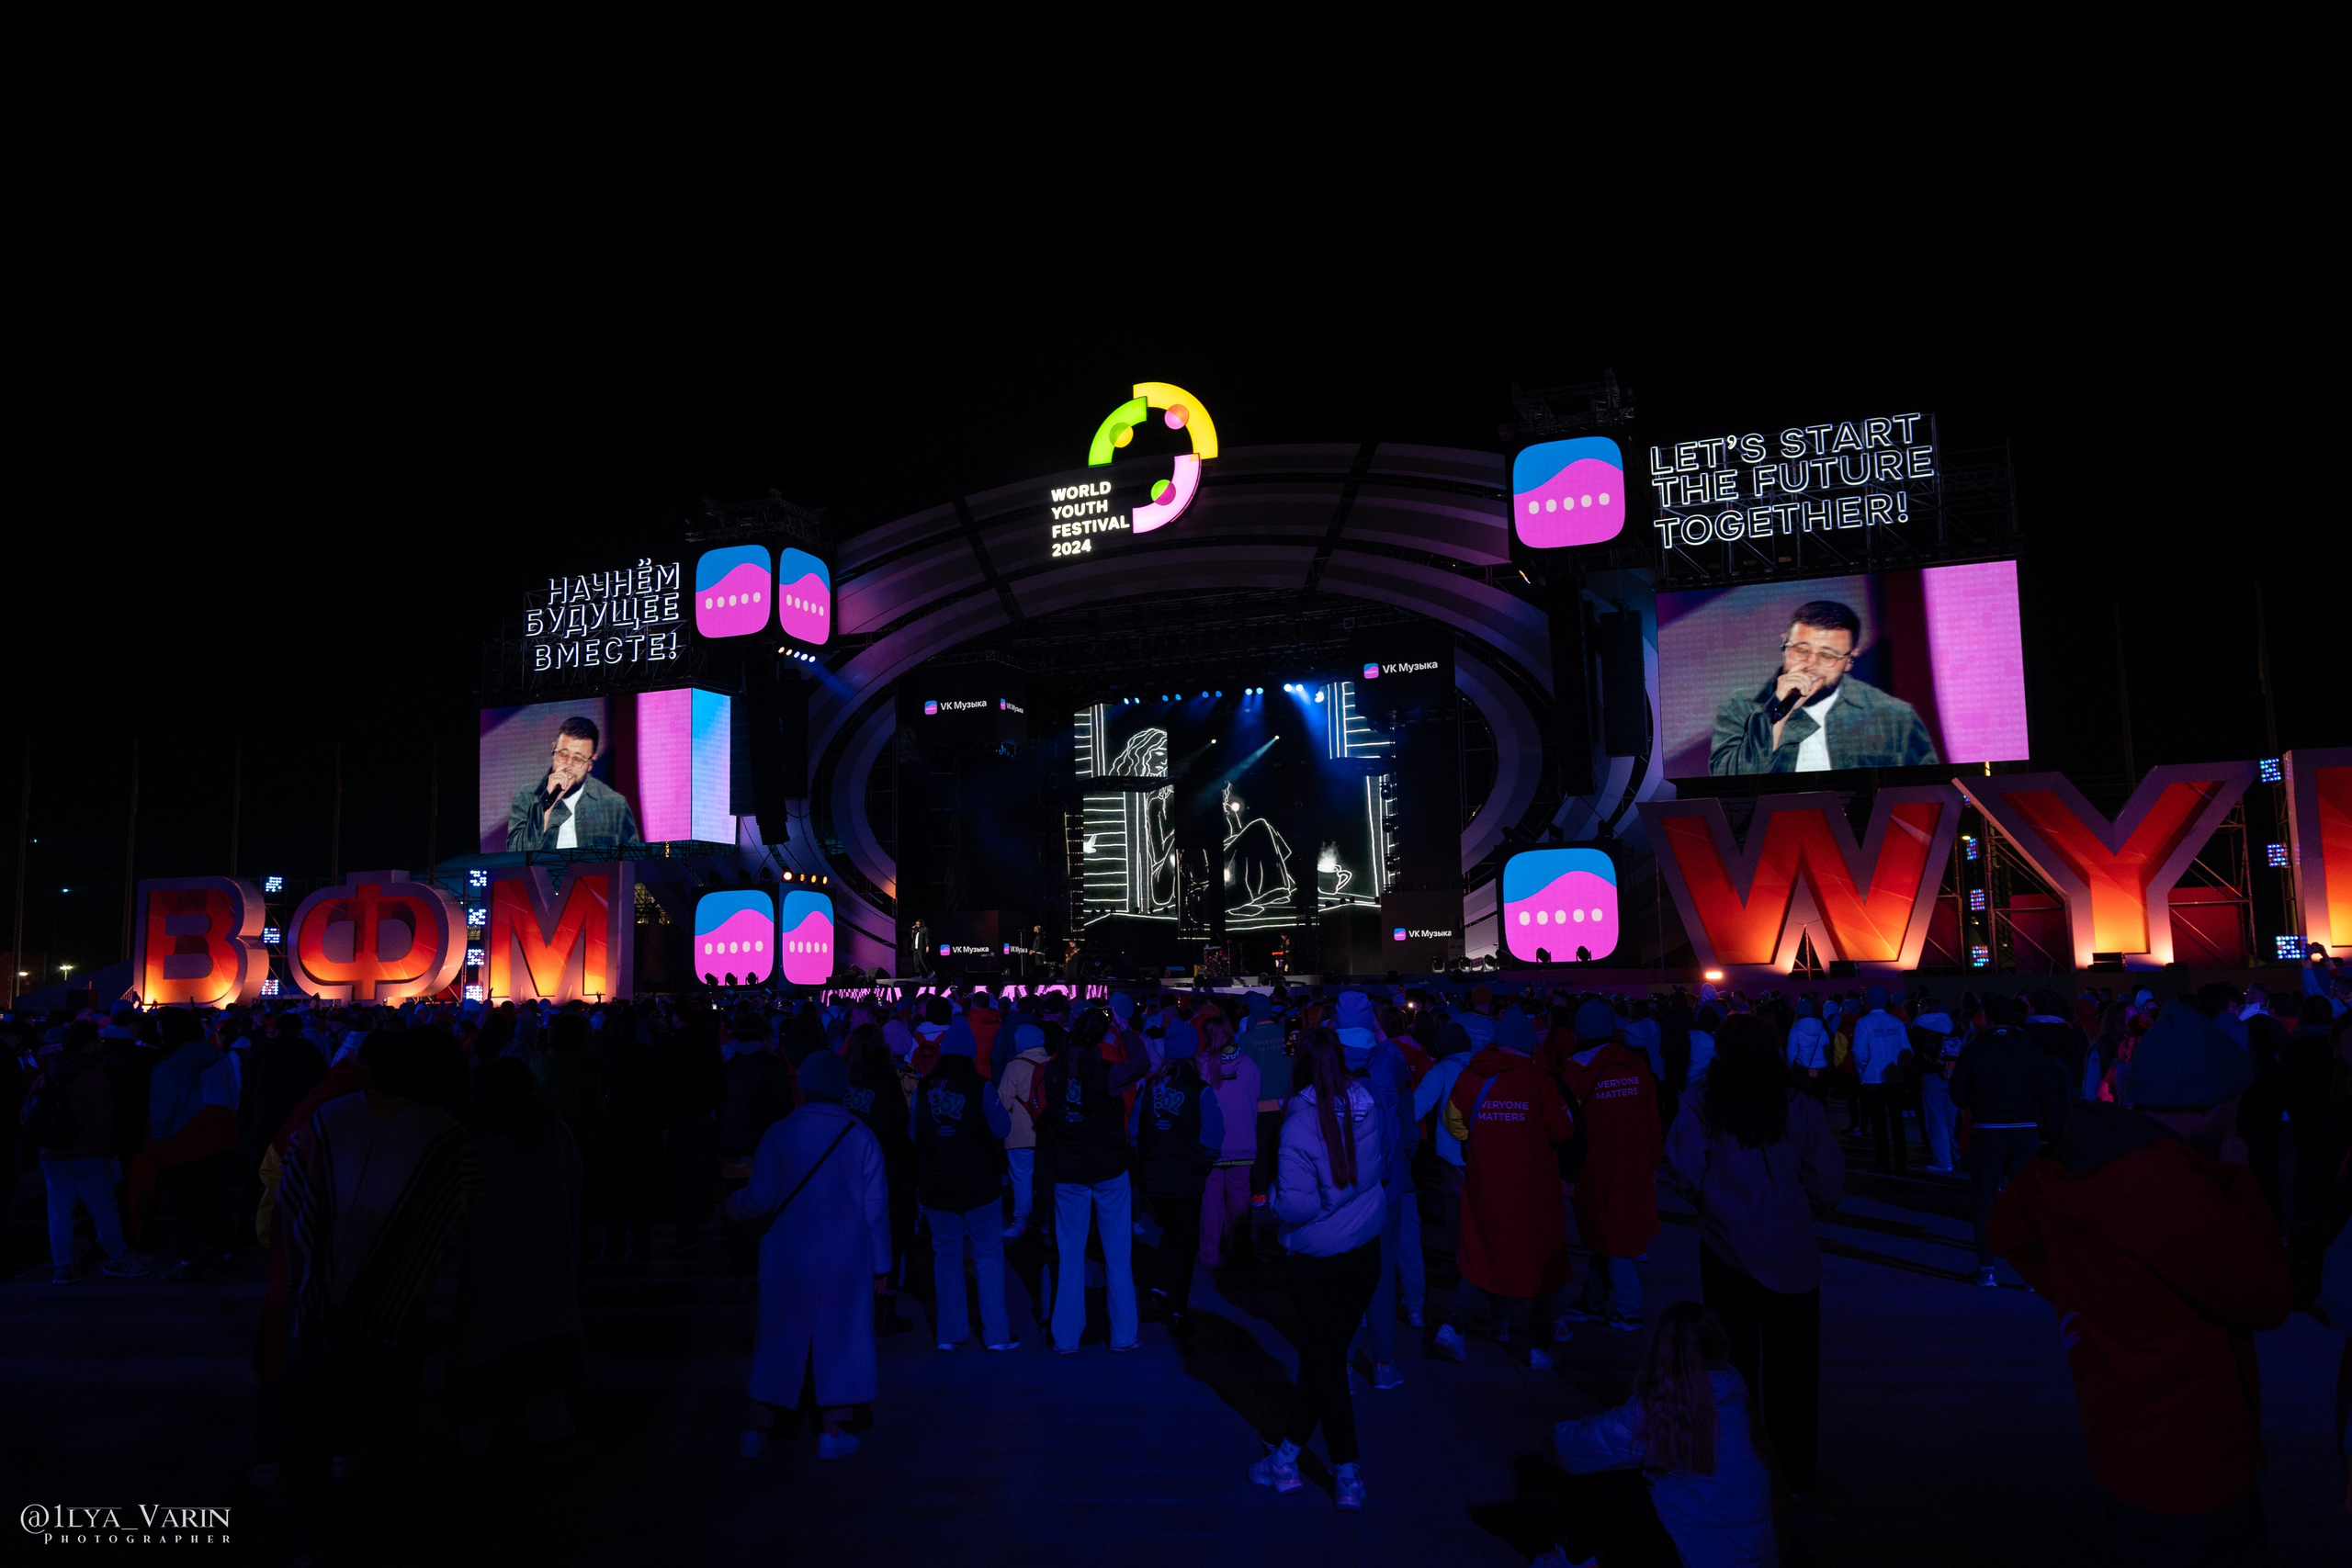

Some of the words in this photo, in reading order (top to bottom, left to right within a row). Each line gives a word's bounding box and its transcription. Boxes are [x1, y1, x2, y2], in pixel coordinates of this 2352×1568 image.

[1780, 412, 1921, 457] START
[1652, 469, 1739, 507] THE
[1753, 446, 1935, 497] FUTURE
[1051, 481, 1112, 502] WORLD
[1051, 500, 1108, 520] YOUTH
[1052, 515, 1130, 538] FESTIVAL
[1654, 491, 1909, 549] TOGETHER!
[1052, 539, 1091, 558] 2024
[548, 558, 681, 606] НАЧНЁМ
[526, 592, 680, 638] БУДУЩЕЕ
[534, 633, 678, 671] ВМЕСТЕ!
[1383, 663, 1397, 673] VK
[1398, 660, 1438, 673] Музыка
[940, 702, 953, 711] VK
[954, 700, 988, 711] Музыка
[1408, 930, 1420, 938] VK
[1421, 930, 1452, 939] Музыка
[963, 946, 989, 954] Музыка
[1253, 1038, 1282, 1046] EVERYON
[1594, 1076, 1640, 1089] VERYONE
[1596, 1088, 1639, 1100] MATTERS
[1480, 1100, 1530, 1111] VERYONE
[1477, 1111, 1526, 1122] MATTERS
